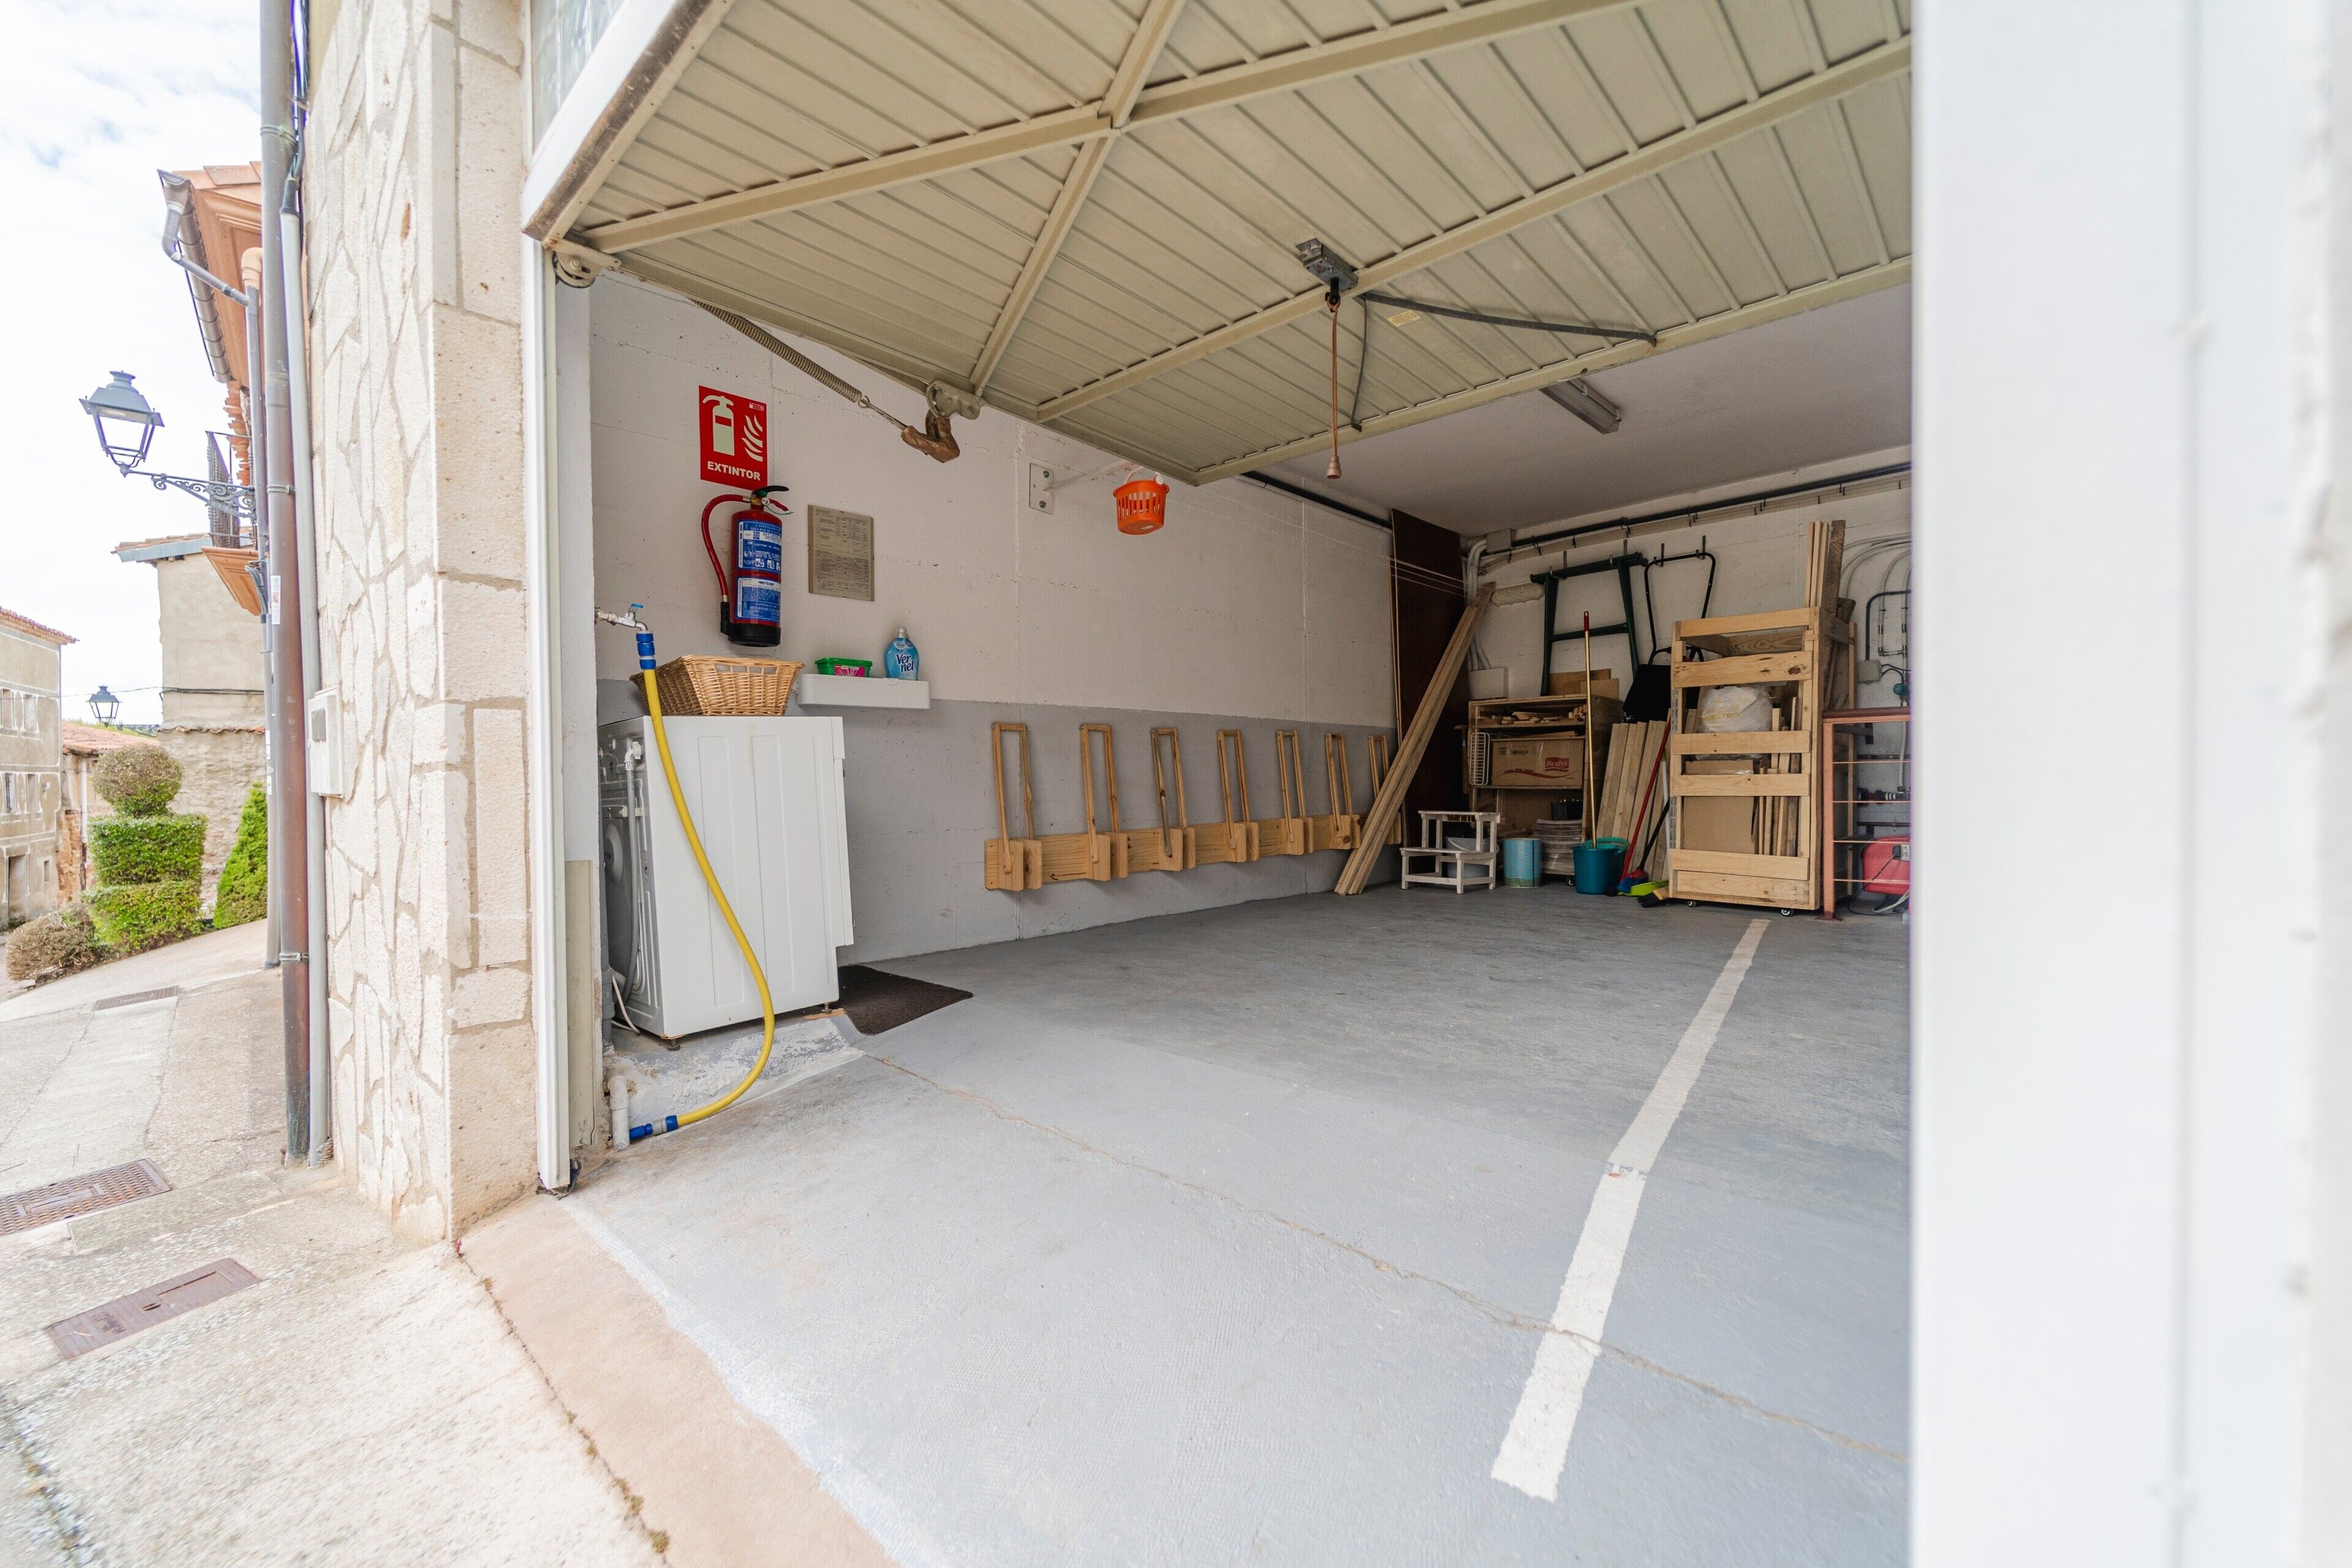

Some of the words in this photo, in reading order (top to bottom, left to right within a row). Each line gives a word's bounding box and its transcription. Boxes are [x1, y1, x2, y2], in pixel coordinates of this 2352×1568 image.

[707, 461, 761, 481] EXTINTOR
[896, 654, 911, 665] Ver
[901, 661, 914, 673] nel
